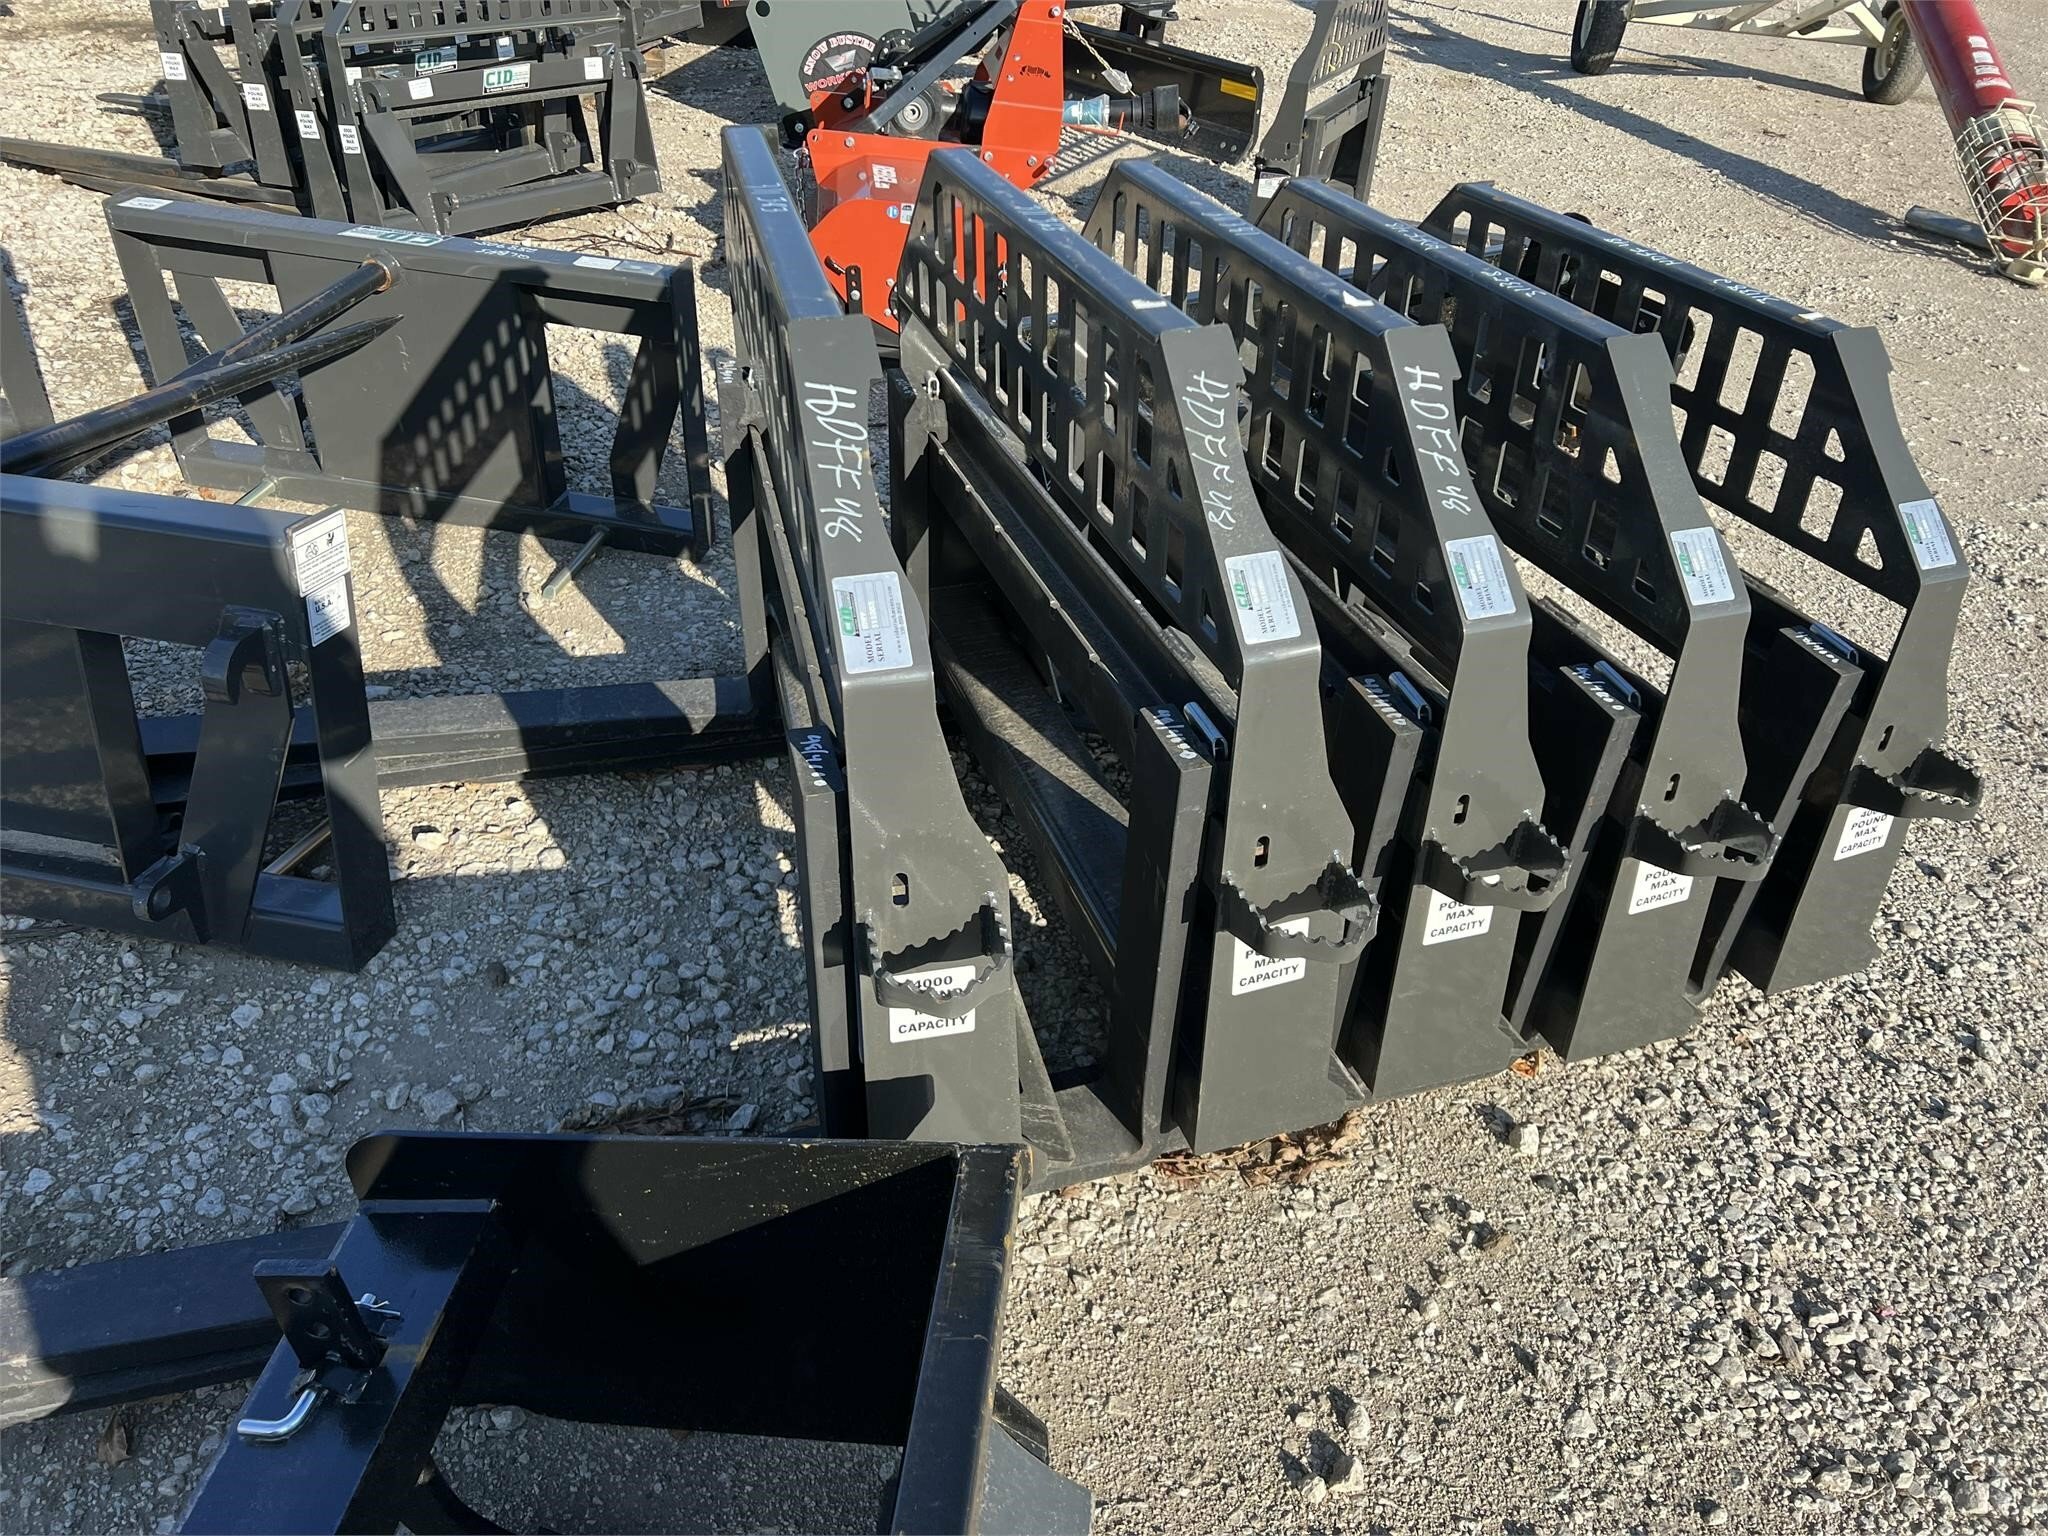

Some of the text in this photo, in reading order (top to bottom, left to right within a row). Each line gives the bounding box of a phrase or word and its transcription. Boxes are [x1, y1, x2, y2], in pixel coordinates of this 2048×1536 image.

[416, 51, 442, 70] CID
[803, 41, 829, 76] SNOW
[485, 68, 514, 87] CID
[838, 605, 855, 636] CID
[1255, 606, 1269, 634] MODEL
[1263, 604, 1277, 633] SERIAL
[862, 632, 875, 664] MODEL
[872, 630, 885, 662] SERIAL
[1854, 826, 1878, 839] MAX
[1839, 835, 1884, 854] CAPACITY
[1650, 877, 1678, 890] MAX
[1635, 887, 1686, 907] CAPACITY
[1445, 908, 1476, 921] MAX
[1430, 919, 1486, 938] CAPACITY
[1239, 964, 1300, 987] CAPACITY
[898, 1015, 969, 1034] CAPACITY
